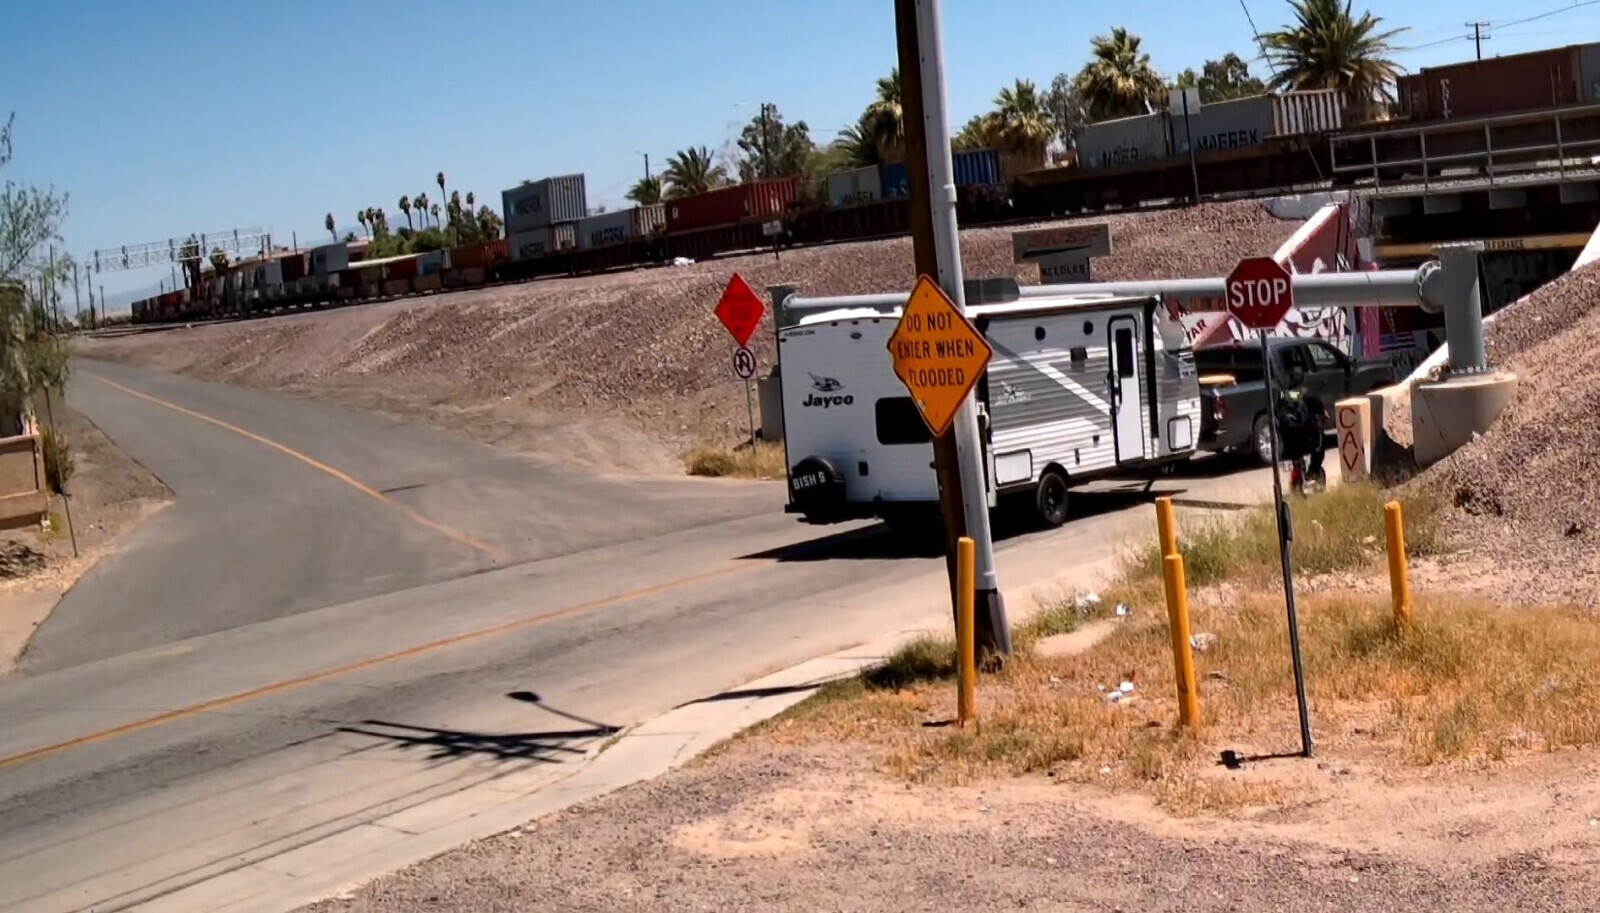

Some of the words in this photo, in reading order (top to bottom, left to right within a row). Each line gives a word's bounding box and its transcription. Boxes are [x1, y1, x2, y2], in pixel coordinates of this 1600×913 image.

[1197, 129, 1259, 152] MAERSK
[1102, 147, 1157, 168] MAER
[1231, 278, 1287, 308] STOP
[906, 313, 921, 332] DO
[927, 311, 953, 331] NOT
[897, 340, 931, 359] ENTER
[935, 339, 975, 358] WHEN
[908, 368, 965, 388] FLOODED
[802, 393, 854, 409] Jayco
